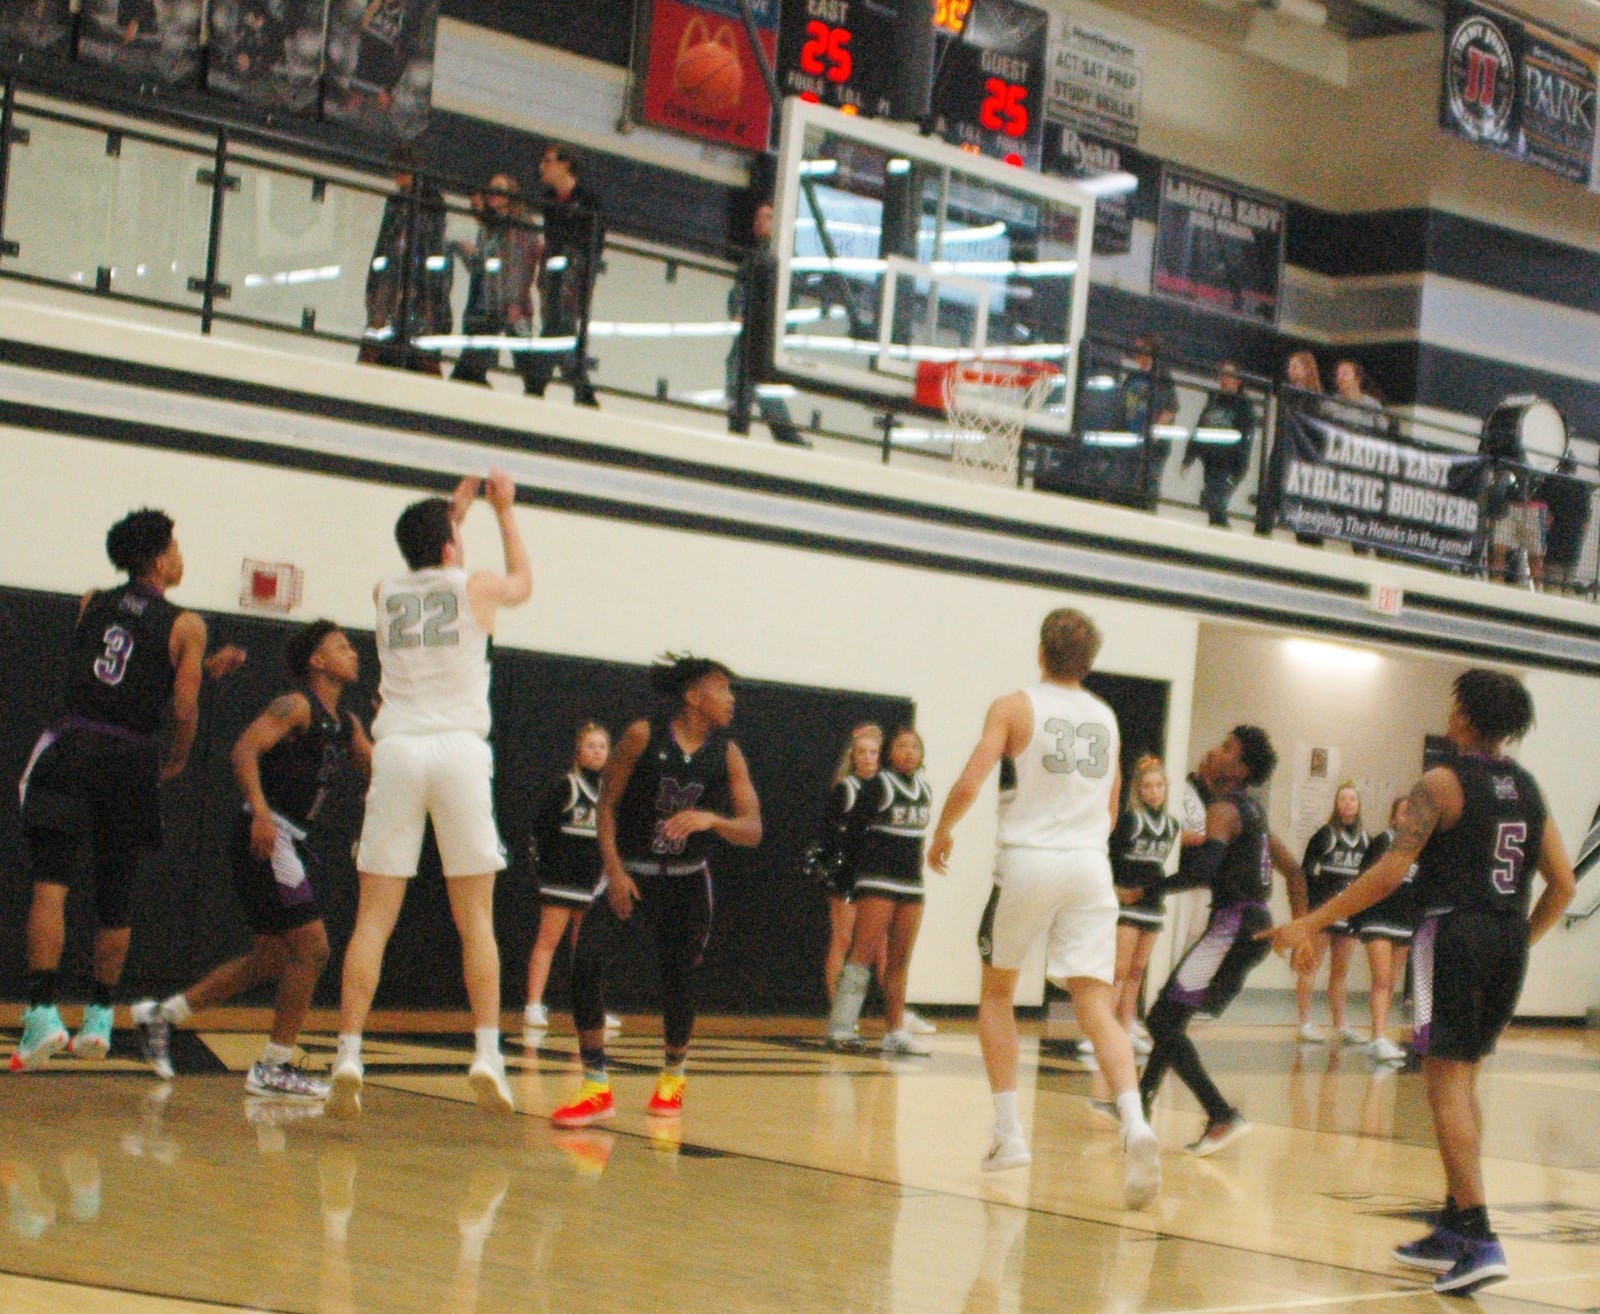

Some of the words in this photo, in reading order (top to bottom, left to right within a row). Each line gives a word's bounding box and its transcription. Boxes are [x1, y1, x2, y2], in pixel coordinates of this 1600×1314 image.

[801, 20, 853, 83] 25
[981, 48, 1028, 80] GUEST
[980, 77, 1028, 137] 25
[1526, 64, 1595, 131] PARK
[1061, 128, 1120, 171] Ryan
[1325, 431, 1400, 474] LAKOTA
[1402, 451, 1452, 487] EAST
[1286, 459, 1385, 512] ATHLETIC
[1387, 481, 1480, 532] BOOSTERS
[1345, 515, 1367, 535] The
[1367, 521, 1405, 543] Hawks
[1407, 527, 1418, 545] in
[1419, 531, 1437, 550] the
[386, 591, 460, 648] 22
[93, 625, 134, 686] 3
[1042, 717, 1110, 779] 33
[1492, 822, 1527, 894] 5
